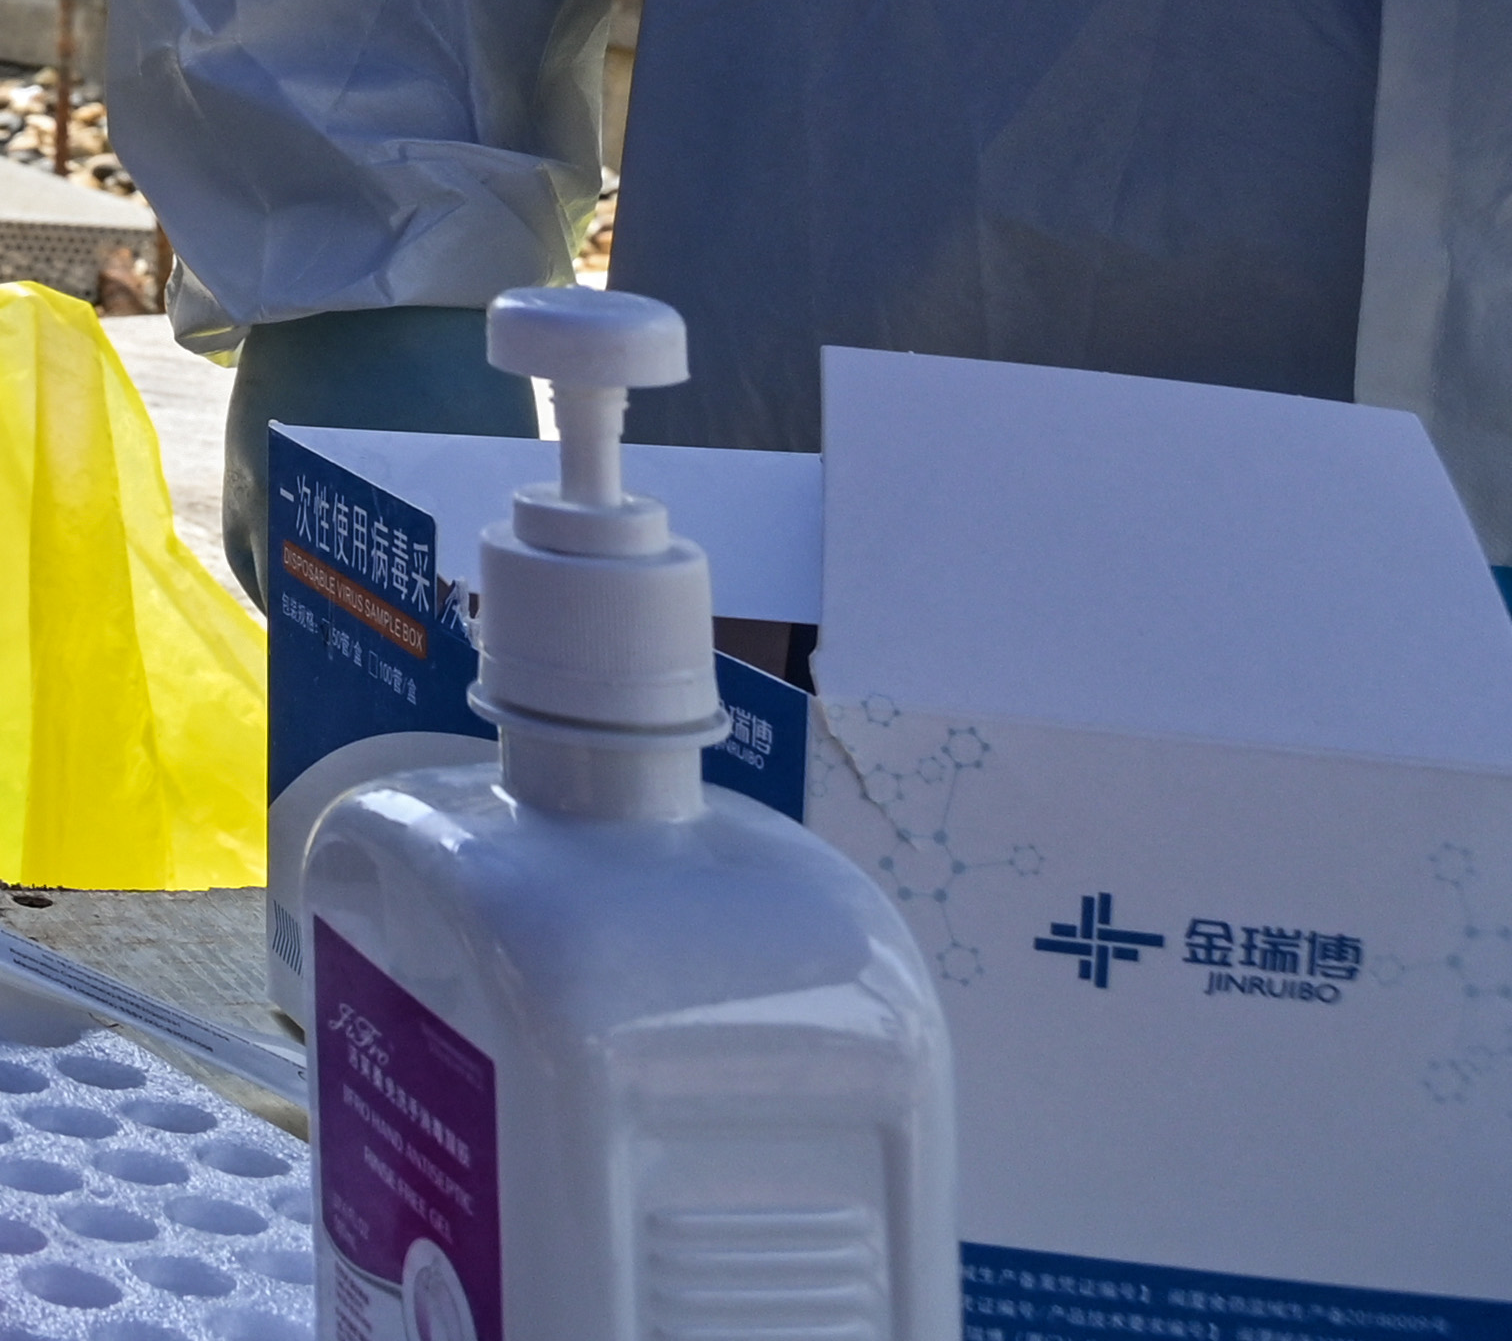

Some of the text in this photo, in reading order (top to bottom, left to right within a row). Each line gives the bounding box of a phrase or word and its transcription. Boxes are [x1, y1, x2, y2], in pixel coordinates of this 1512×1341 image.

[279, 474, 431, 613] 一次性使用病毒采
[283, 546, 425, 652] DISPOSABLE VIRUS SAMPLE BOX
[1181, 916, 1363, 981] 金瑞博
[1204, 970, 1342, 1005] JINRUIBO
